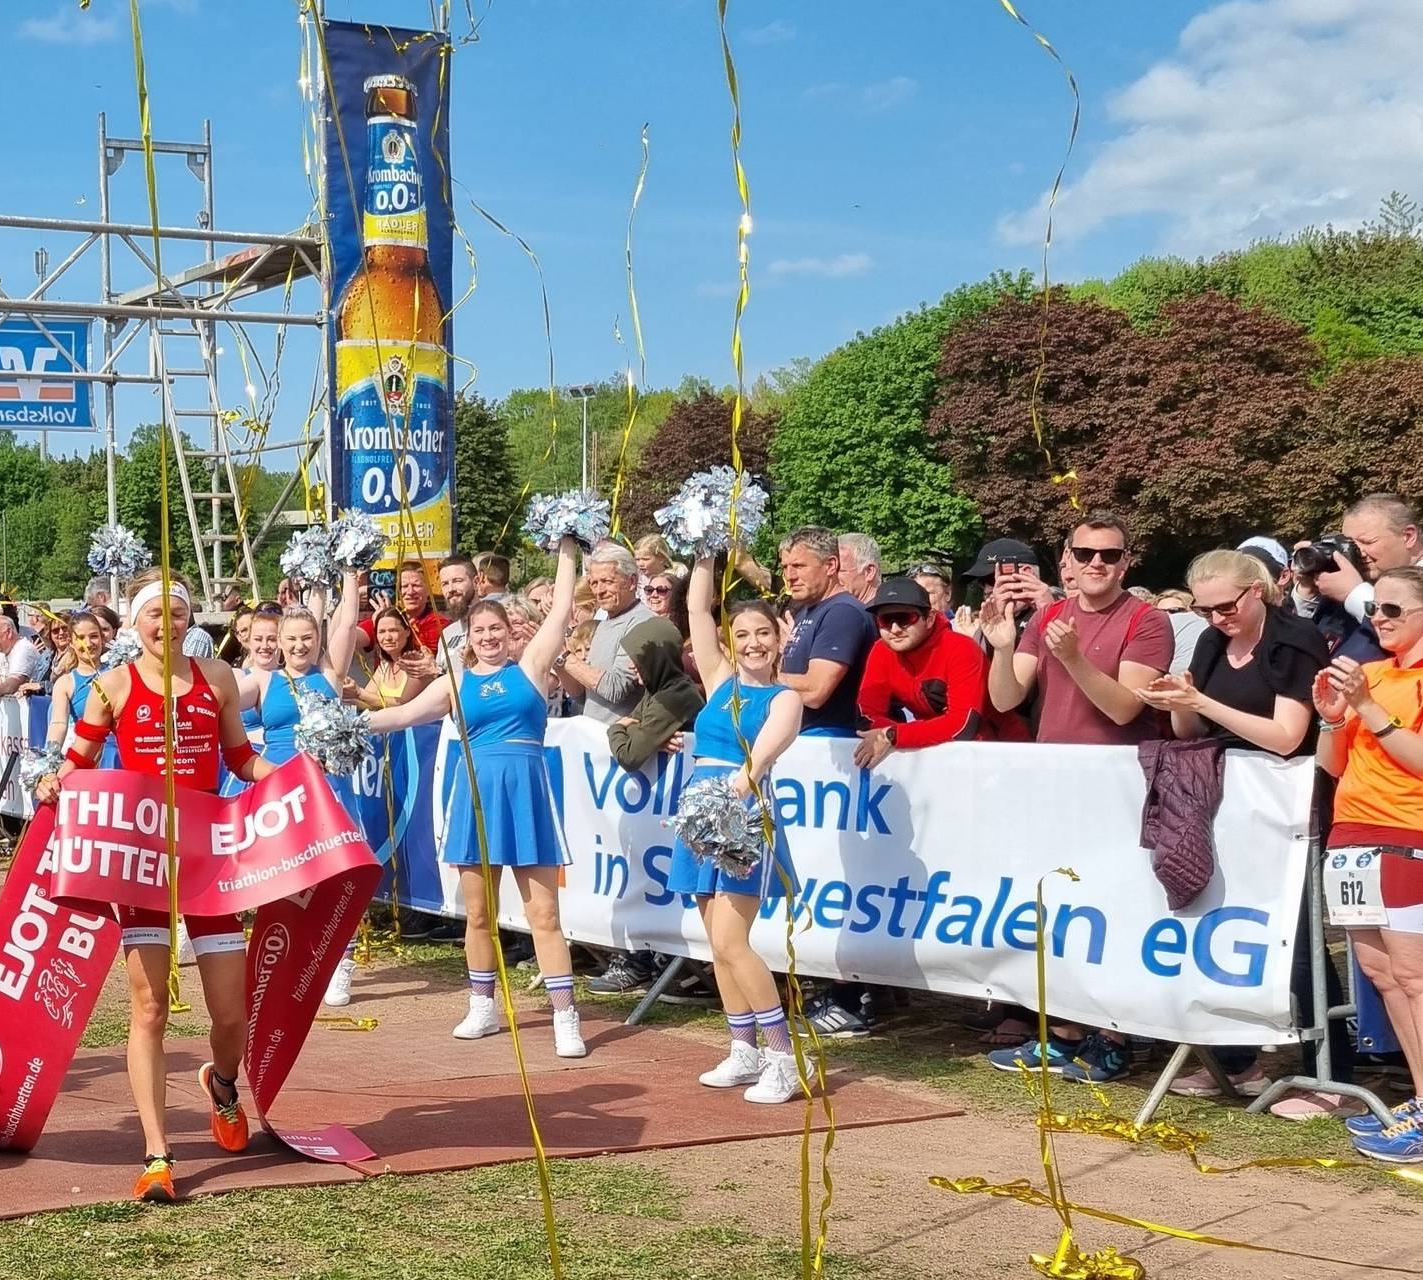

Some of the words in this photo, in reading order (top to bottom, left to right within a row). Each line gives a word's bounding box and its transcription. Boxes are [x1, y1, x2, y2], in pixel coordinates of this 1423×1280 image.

[368, 164, 423, 187] Krombach
[376, 217, 419, 232] RADLER
[344, 416, 445, 454] Krombacher
[388, 521, 435, 538] DLER
[210, 783, 307, 856] EJOT
[1340, 880, 1367, 906] 612
[594, 833, 630, 899] in
[1141, 904, 1270, 989] eG
[57, 912, 106, 960] BU
